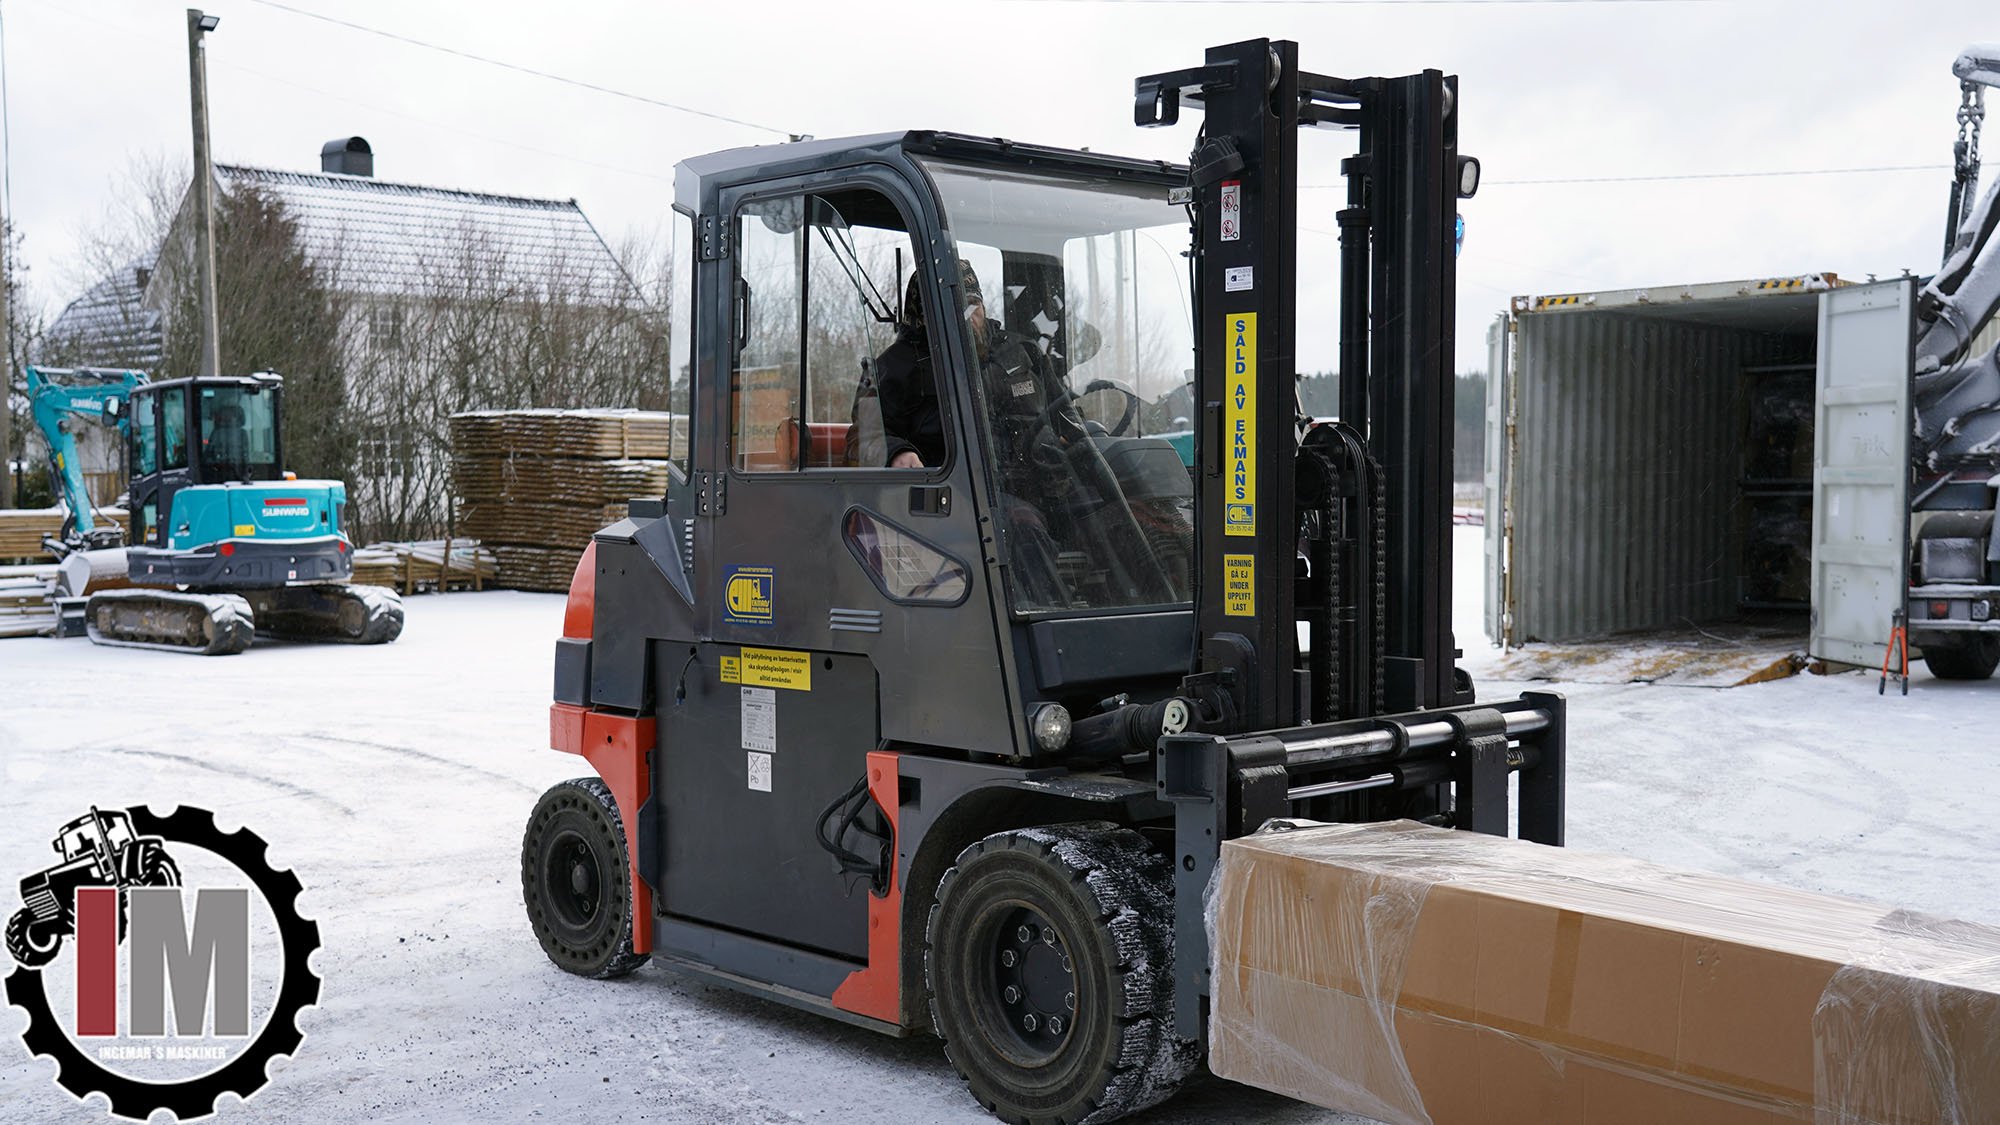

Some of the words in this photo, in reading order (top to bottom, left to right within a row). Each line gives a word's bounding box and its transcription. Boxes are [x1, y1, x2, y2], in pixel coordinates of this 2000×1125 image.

[1235, 320, 1246, 374] SÅLD
[1235, 384, 1246, 410] AV
[71, 396, 102, 411] SUNWARD
[1234, 419, 1247, 500] EKMANS
[262, 507, 309, 517] SUNWARD
[1227, 559, 1252, 567] VARNING
[1231, 569, 1238, 578] GÅ
[1241, 570, 1248, 578] EJ
[1230, 581, 1249, 590] UNDER
[1227, 592, 1251, 600] UPPLYFT
[1232, 603, 1246, 611] LAST
[751, 653, 772, 662] påfyllning
[778, 655, 807, 664] batterivatten
[756, 664, 789, 674] skyddsglasögon
[751, 774, 759, 784] Pb
